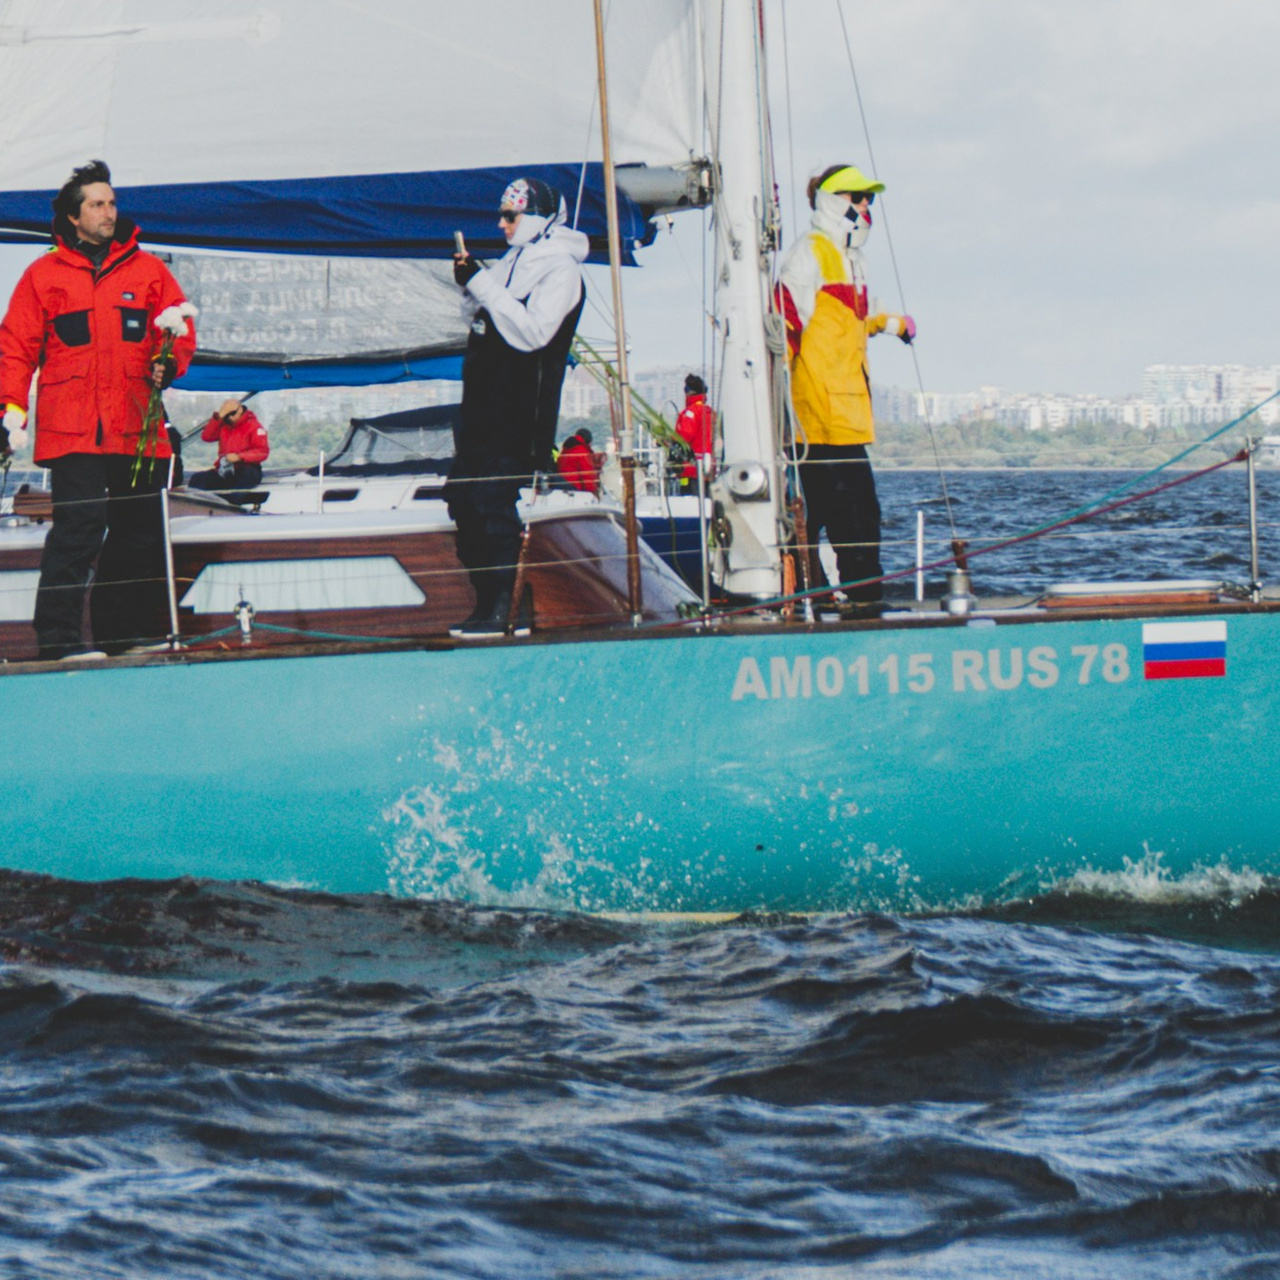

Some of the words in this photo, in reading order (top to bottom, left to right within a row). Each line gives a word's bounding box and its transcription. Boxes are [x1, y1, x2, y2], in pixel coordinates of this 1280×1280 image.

[731, 654, 935, 701] AM0115
[951, 646, 1060, 692] RUS
[1071, 643, 1130, 684] 78
